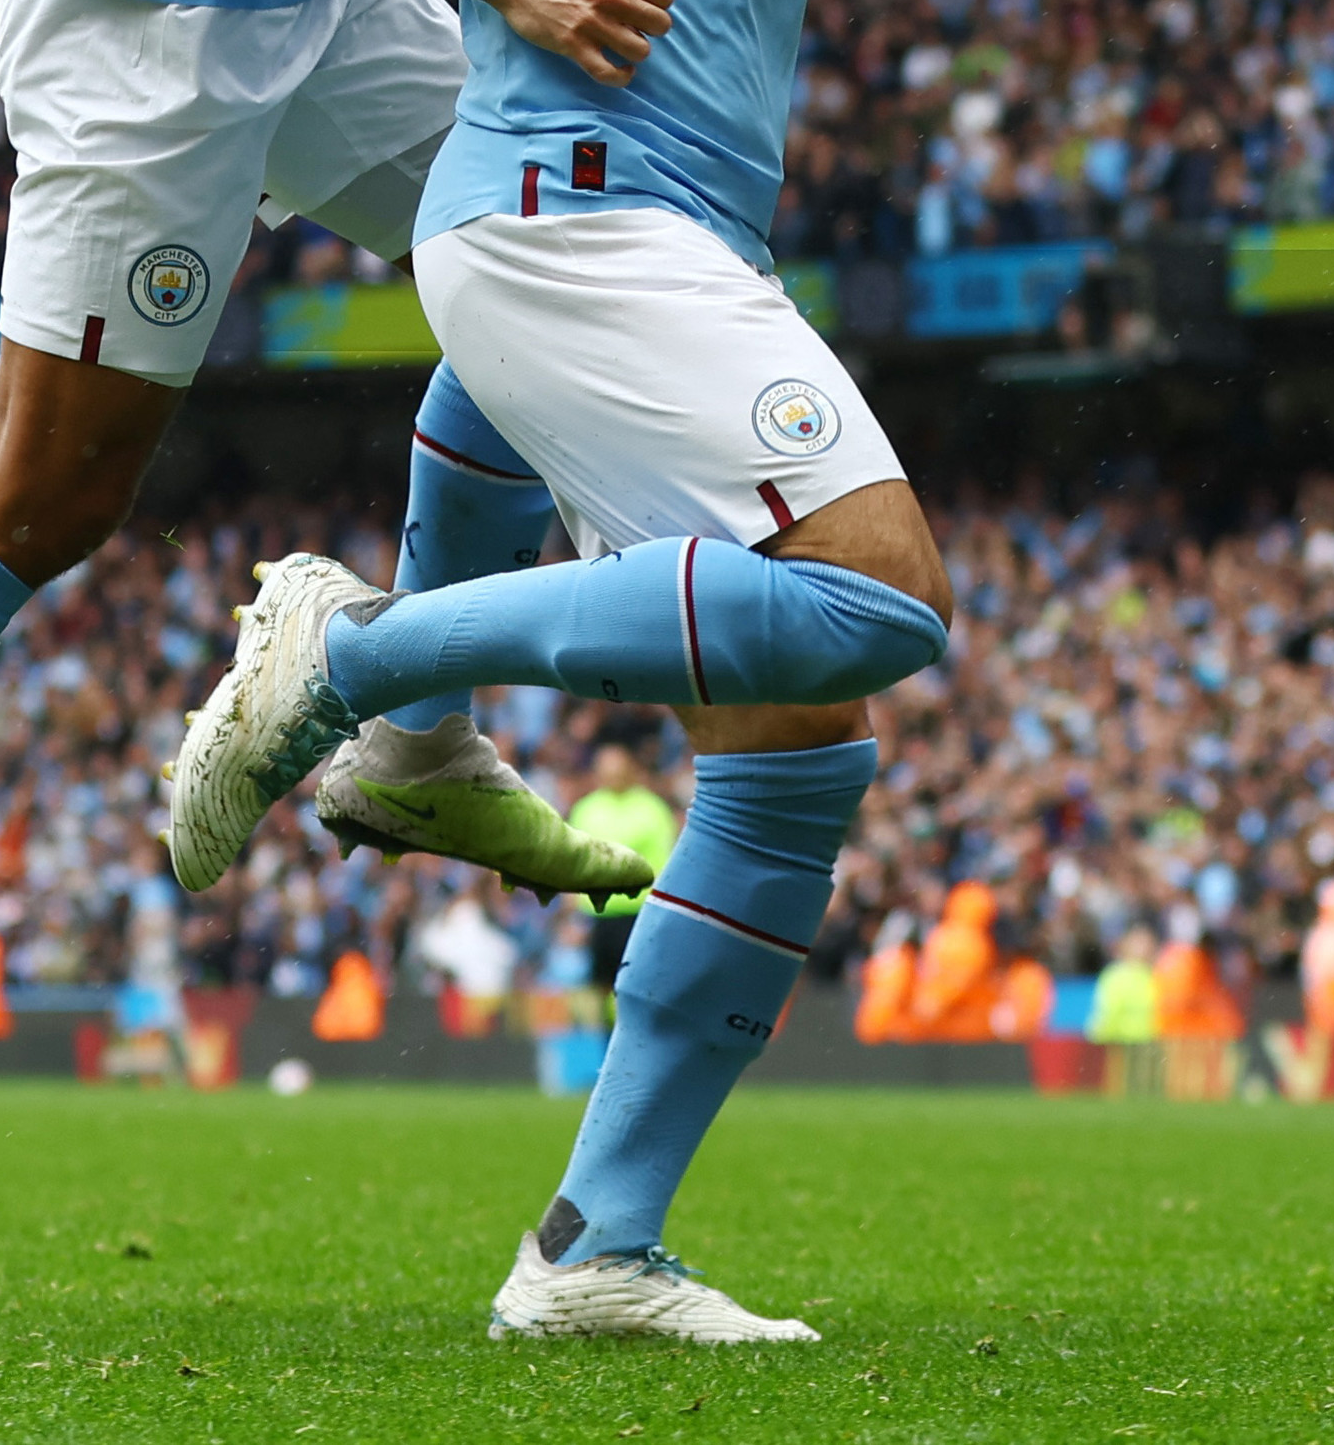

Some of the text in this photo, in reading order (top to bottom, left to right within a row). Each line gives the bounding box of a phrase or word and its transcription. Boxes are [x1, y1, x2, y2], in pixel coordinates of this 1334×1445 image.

[139, 250, 203, 278] MANCHESTER
[154, 311, 178, 321] CITY
[759, 384, 818, 424] MANCHESTER
[805, 435, 828, 452] CITY
